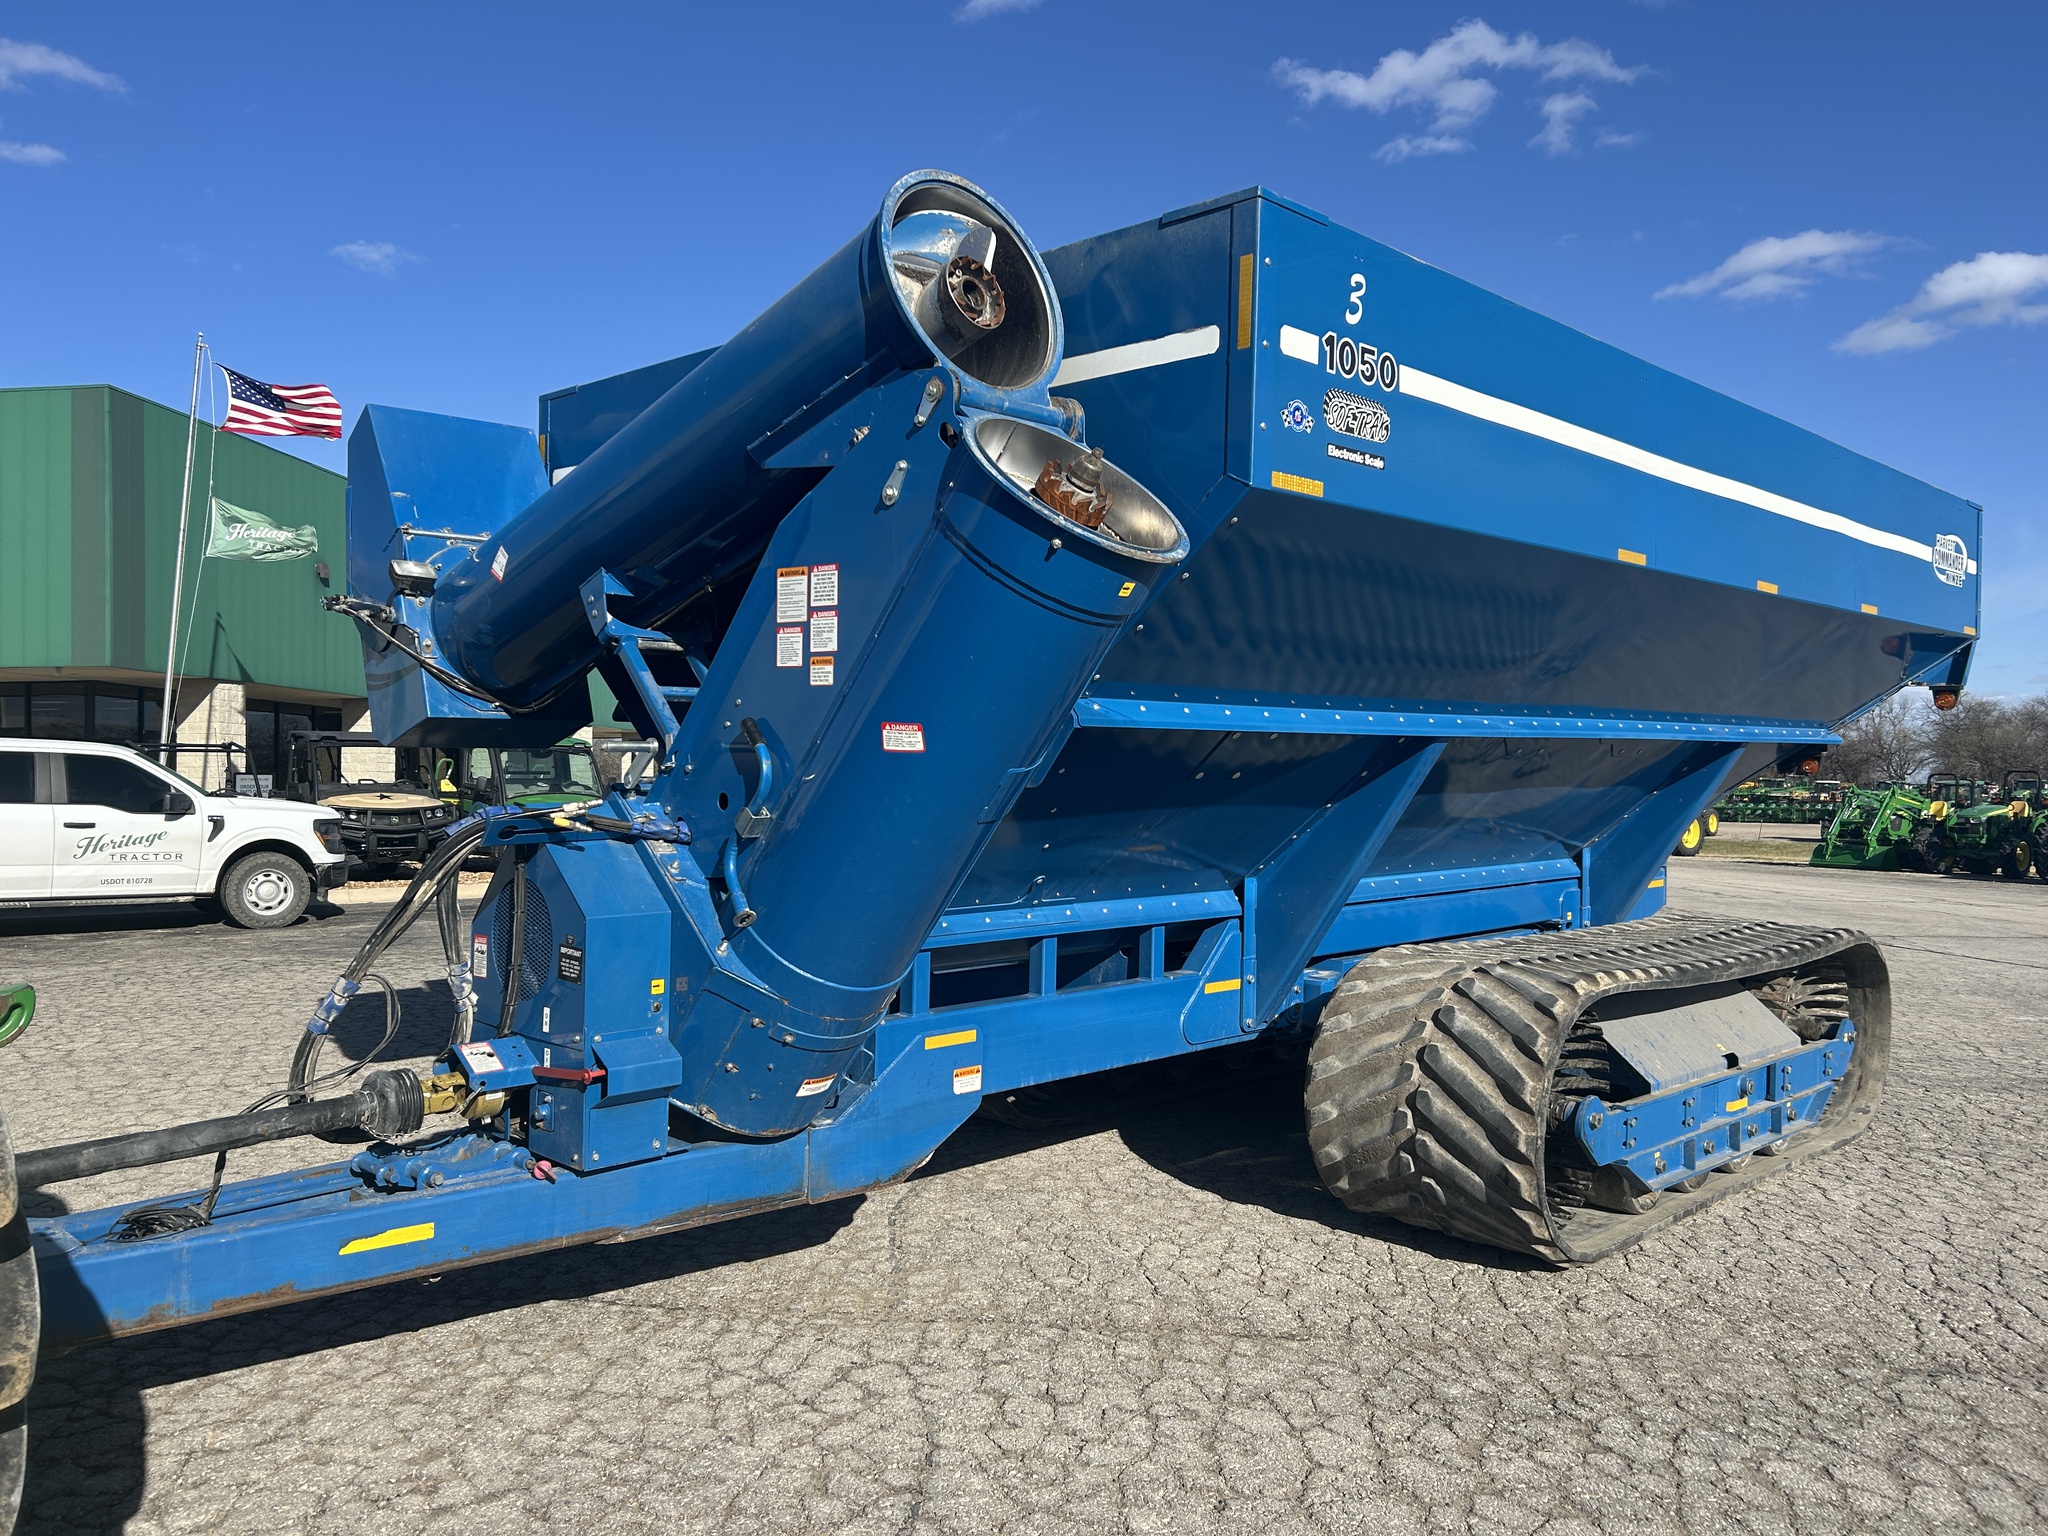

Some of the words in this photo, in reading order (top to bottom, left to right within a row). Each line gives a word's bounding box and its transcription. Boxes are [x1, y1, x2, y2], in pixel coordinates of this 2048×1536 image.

[1345, 273, 1366, 325] 3
[1322, 331, 1397, 390] 1050
[1328, 444, 1364, 464] Electronic
[1365, 454, 1385, 469] Scale
[226, 523, 297, 541] Heritage
[73, 830, 169, 860] Heritage
[109, 853, 183, 861] TRACTOR
[560, 946, 582, 957] IMPORTANT
